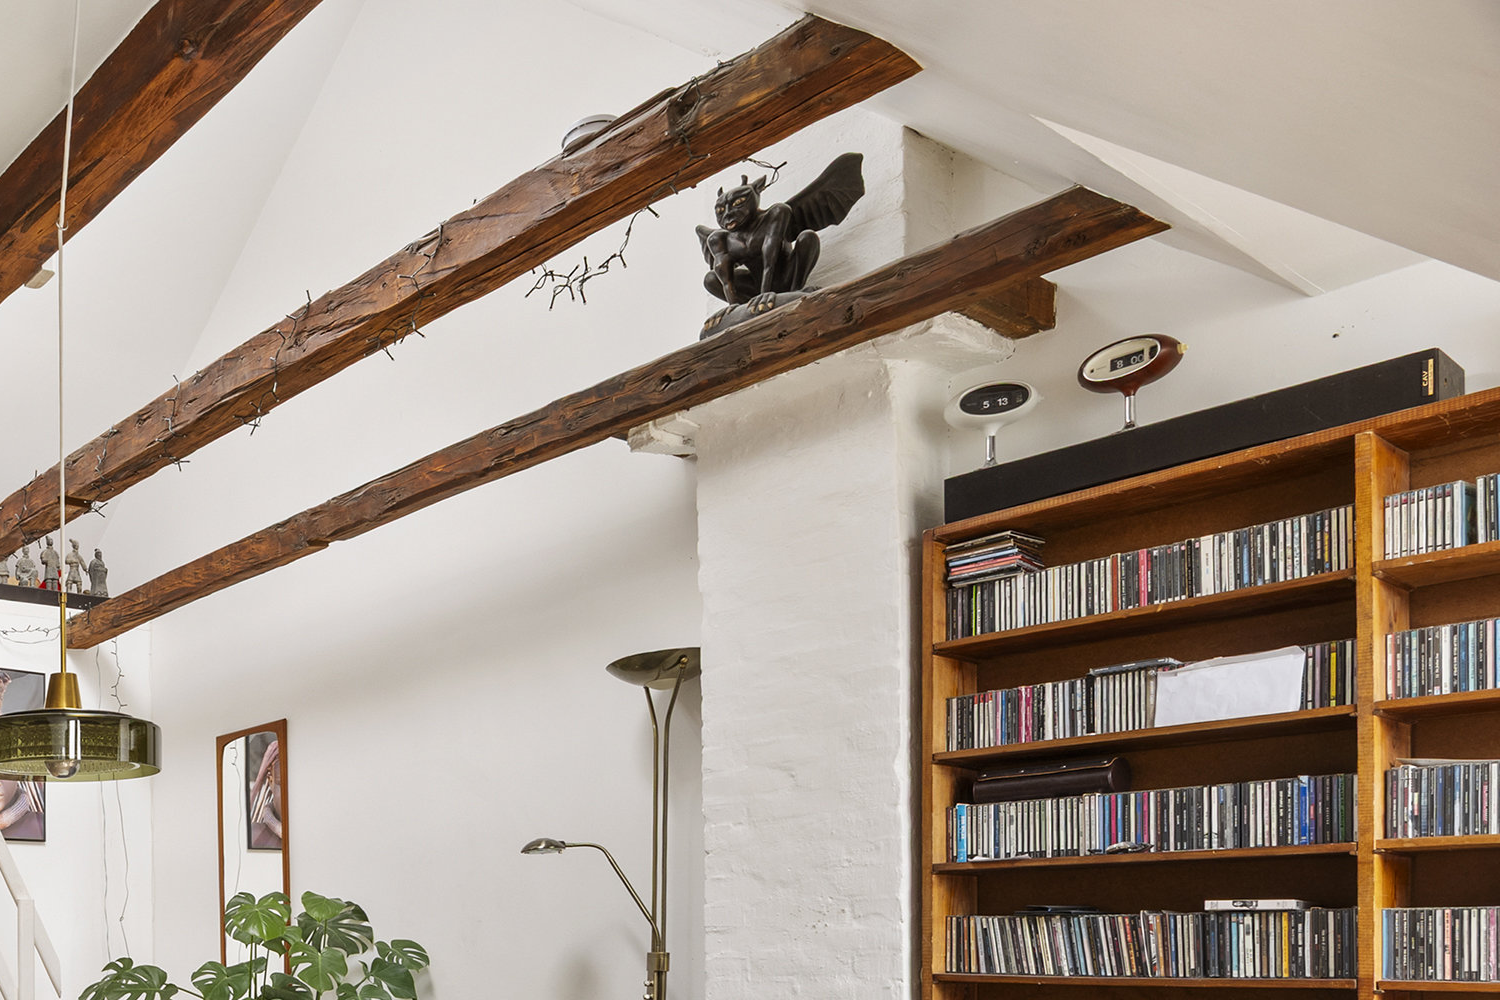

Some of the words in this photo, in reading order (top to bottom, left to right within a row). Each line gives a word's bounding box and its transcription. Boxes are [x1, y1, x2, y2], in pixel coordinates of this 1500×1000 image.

[1116, 360, 1123, 369] 8
[983, 400, 990, 409] 5
[997, 397, 1008, 406] 13
